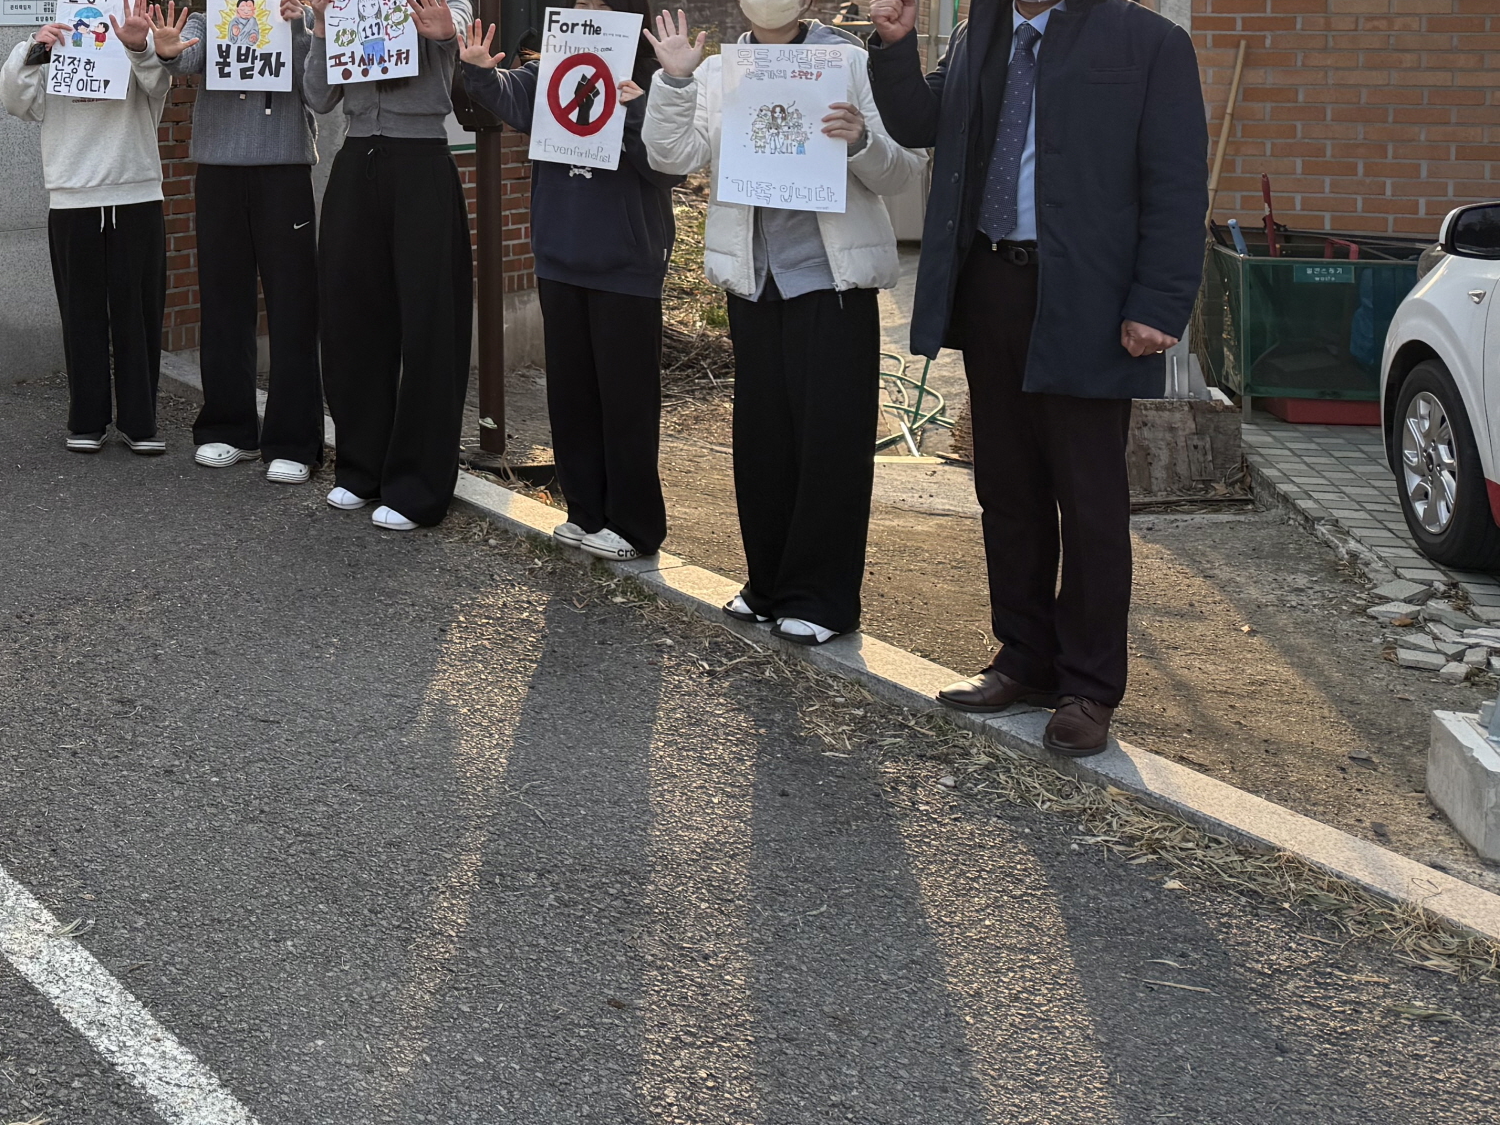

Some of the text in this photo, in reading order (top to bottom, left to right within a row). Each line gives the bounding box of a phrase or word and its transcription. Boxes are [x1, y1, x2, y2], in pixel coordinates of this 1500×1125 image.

[361, 22, 381, 39] 117
[547, 11, 602, 36] For the
